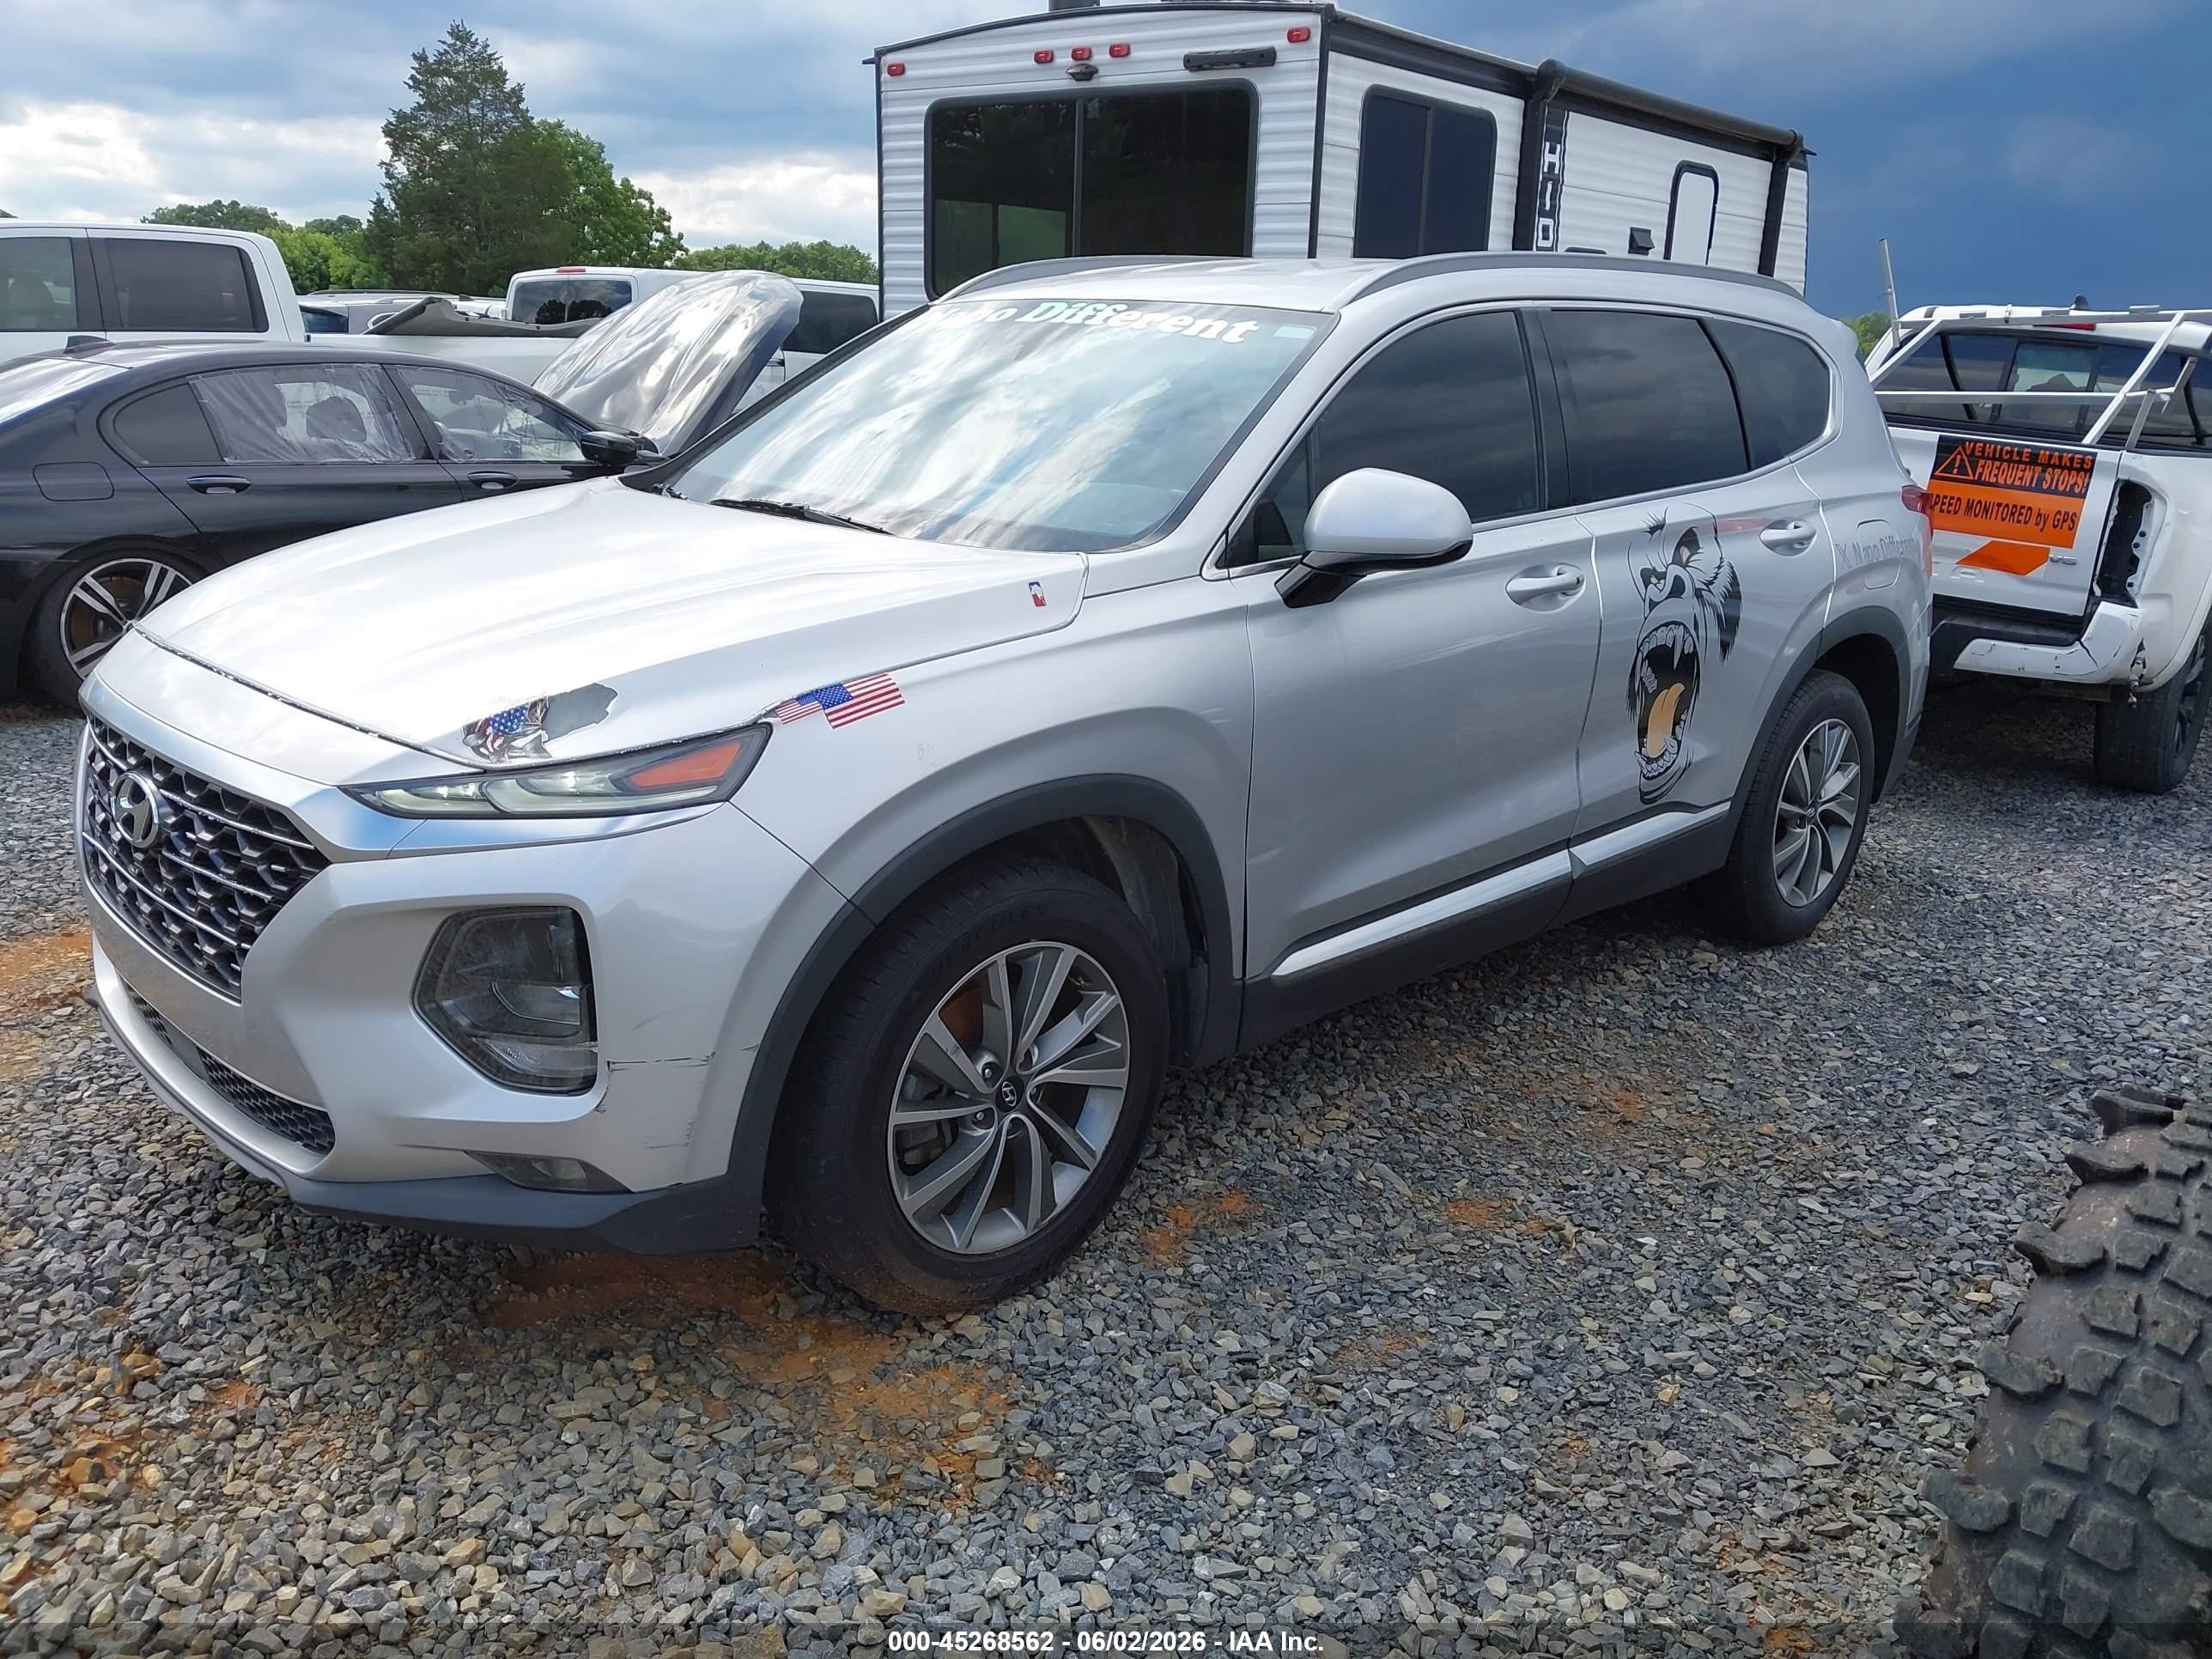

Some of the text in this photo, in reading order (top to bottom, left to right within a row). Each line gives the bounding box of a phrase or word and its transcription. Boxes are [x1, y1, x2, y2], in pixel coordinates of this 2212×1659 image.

[1014, 301, 1261, 343] Different
[1965, 441, 2094, 470] VEHICLE MAKES
[1974, 459, 2090, 495] FREQUENT STOPS!
[1964, 497, 2033, 525] MONITORED
[2034, 507, 2050, 532] by
[2052, 509, 2077, 532] GPS
